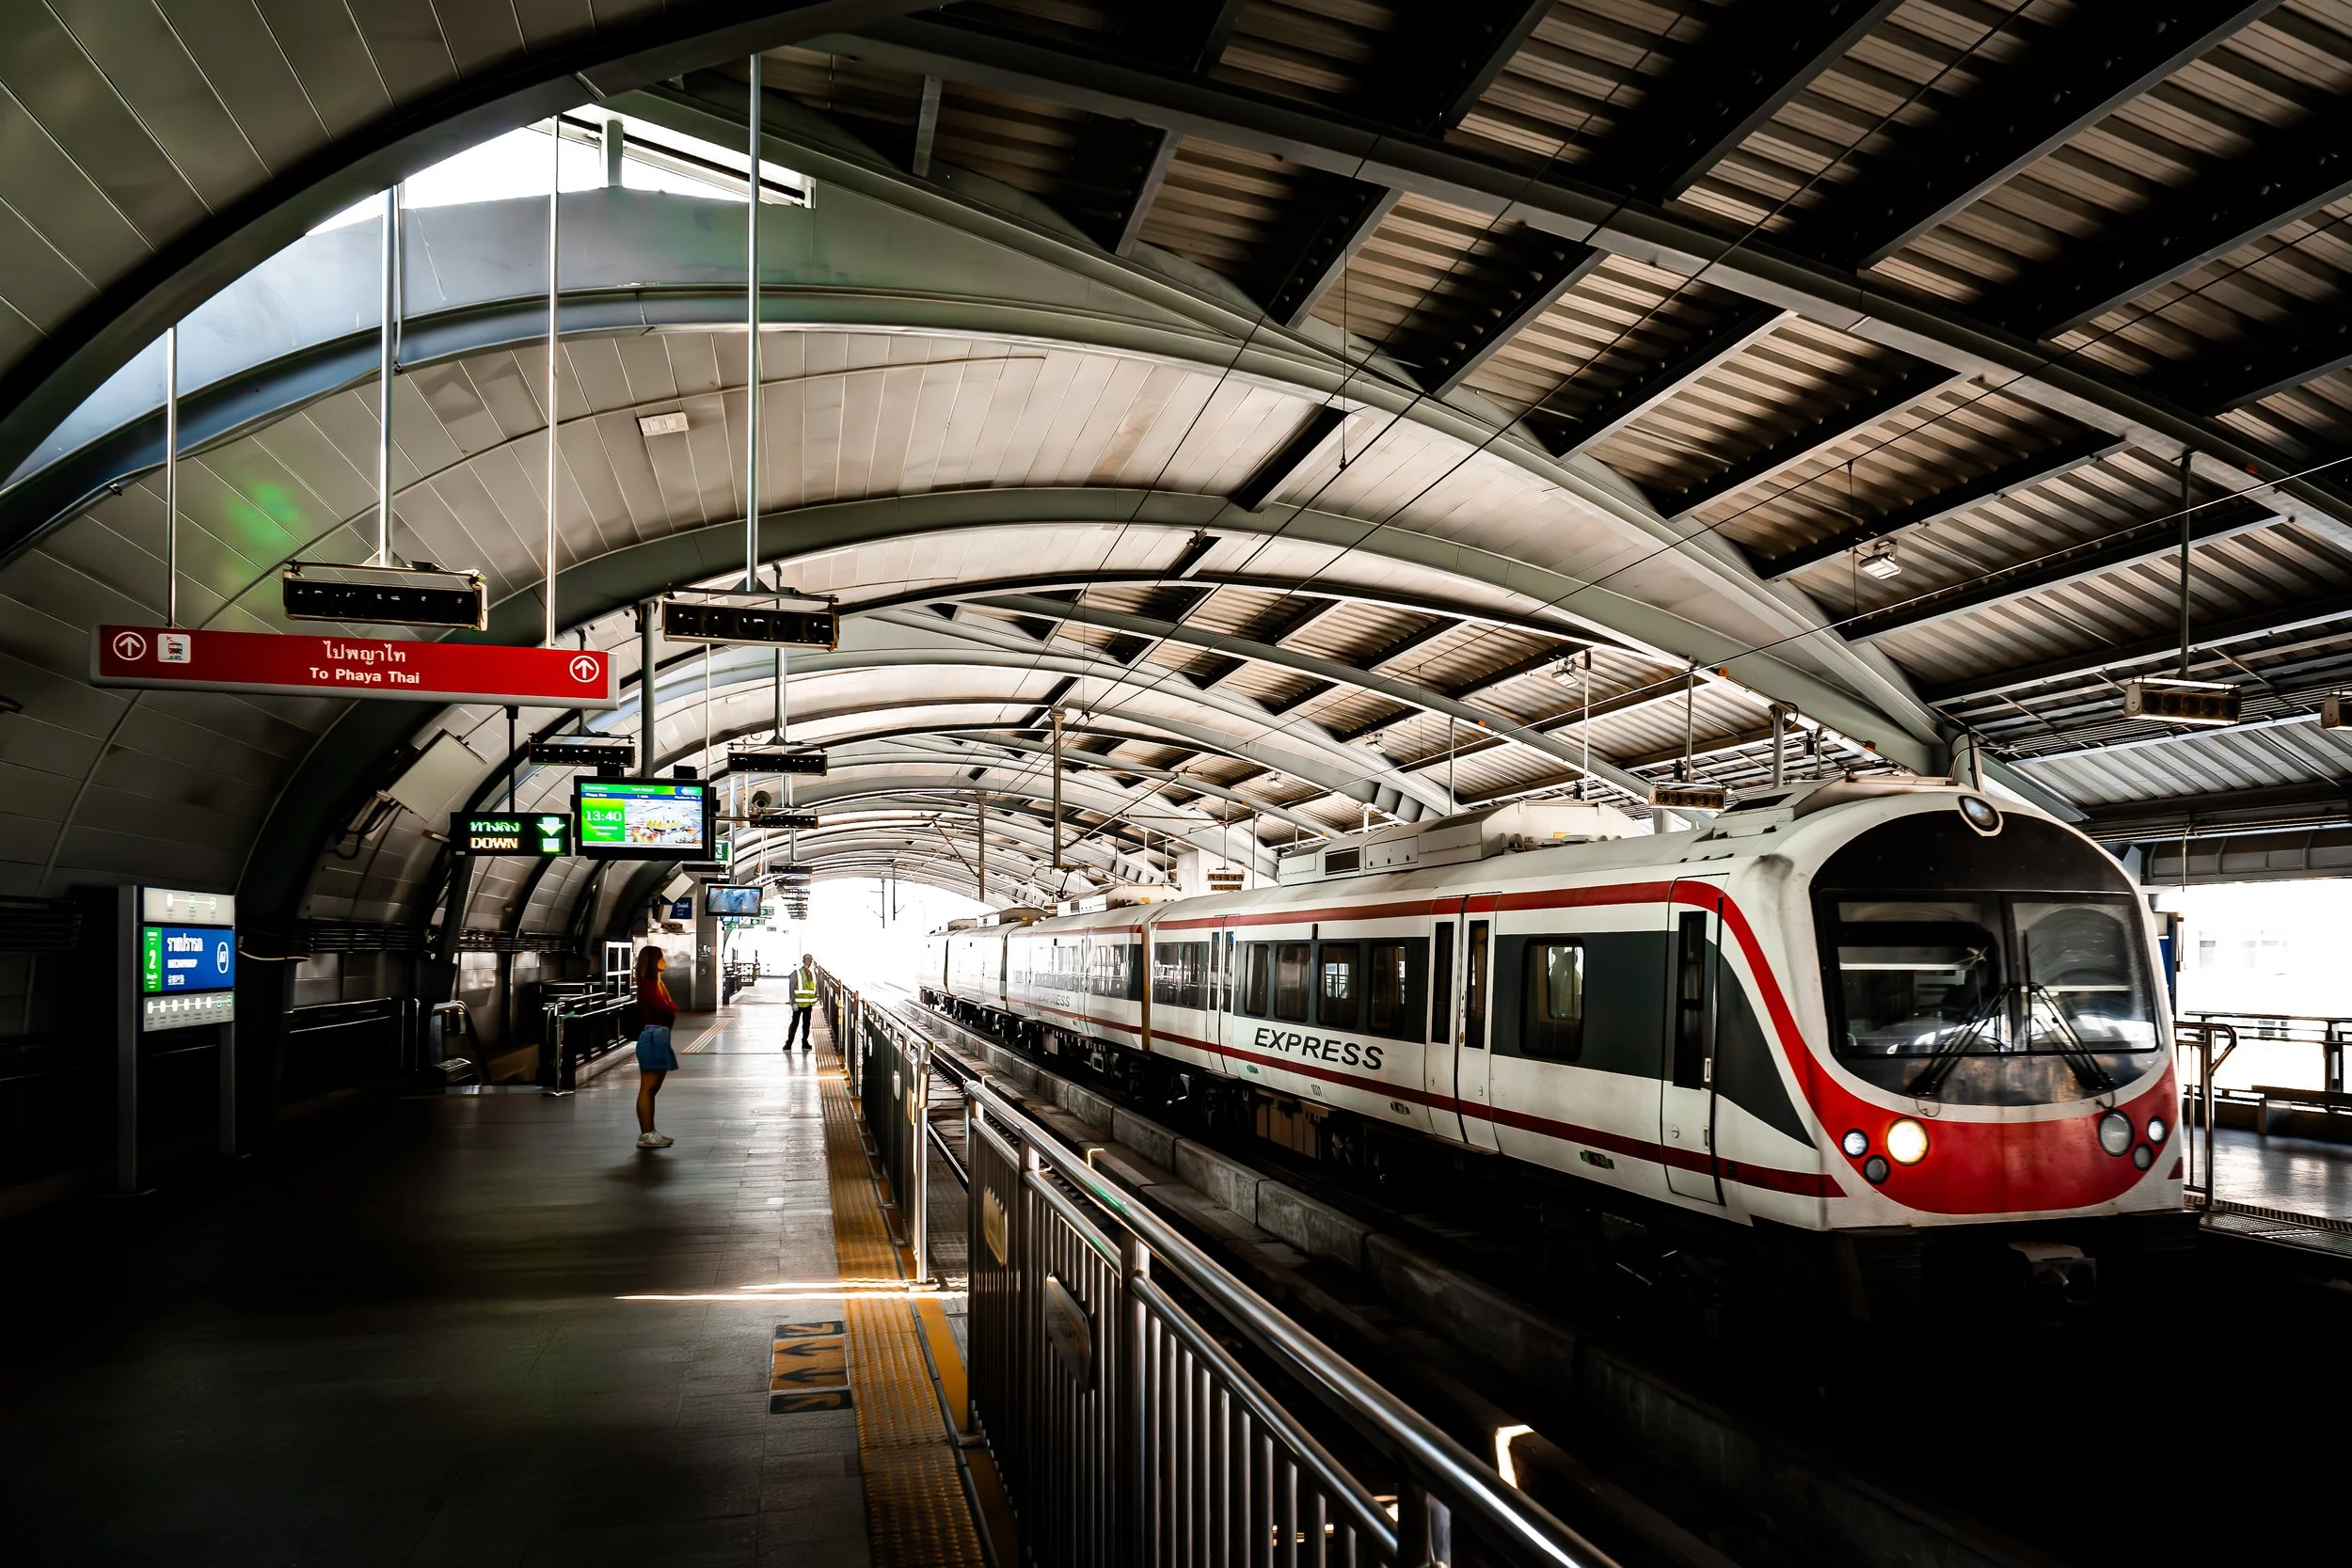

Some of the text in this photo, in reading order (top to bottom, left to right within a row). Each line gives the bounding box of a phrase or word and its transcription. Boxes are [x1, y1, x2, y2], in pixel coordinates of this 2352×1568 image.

[323, 640, 405, 665] ไปพญาไท
[310, 667, 420, 684] To Phaya Thai
[585, 810, 622, 822] 13:40
[470, 821, 520, 832] ทางลง
[470, 837, 518, 849] DOWN
[149, 949, 156, 969] 2
[1254, 1027, 1384, 1070] EXPRESS
